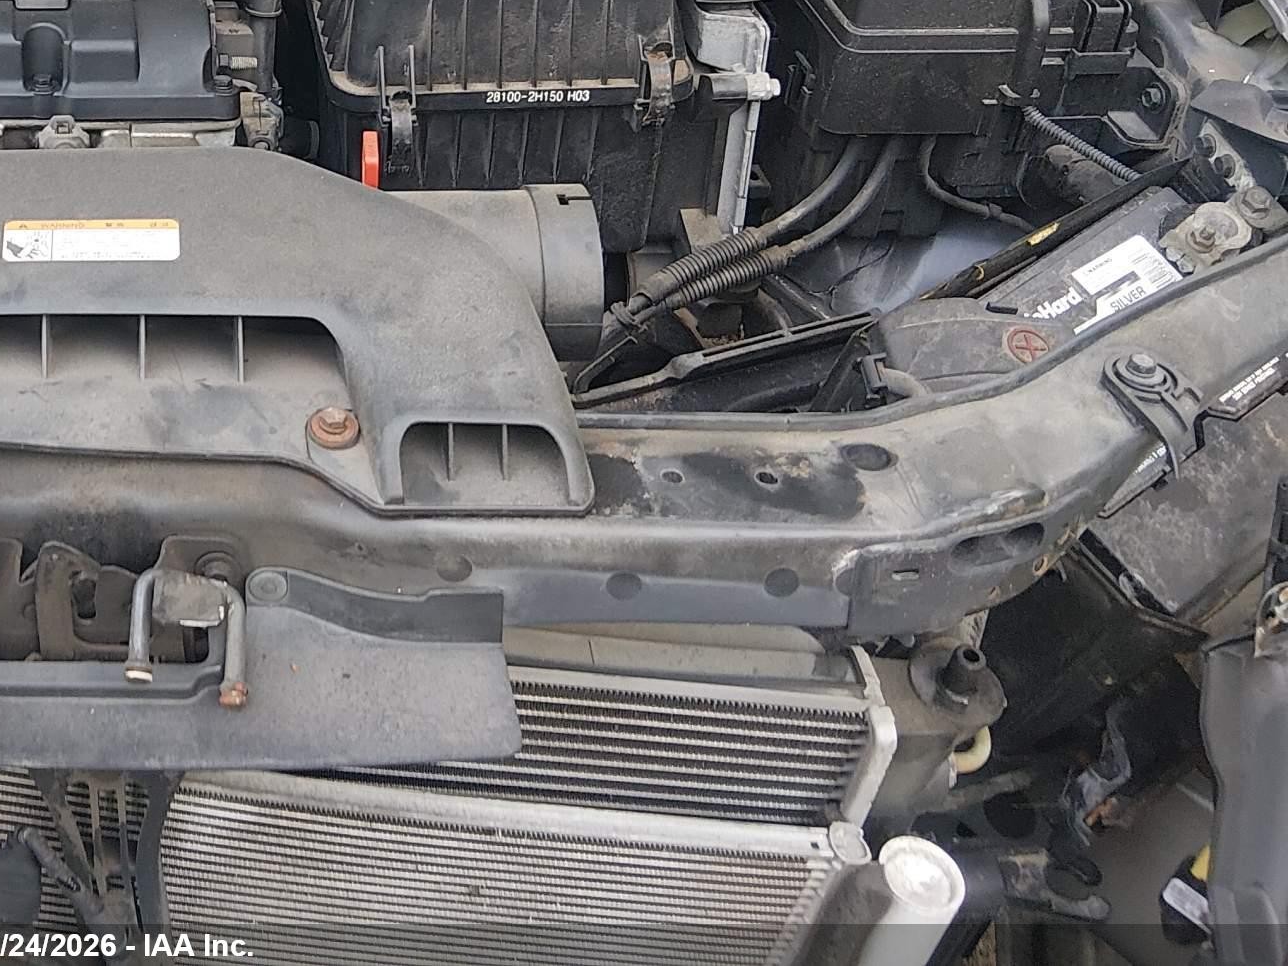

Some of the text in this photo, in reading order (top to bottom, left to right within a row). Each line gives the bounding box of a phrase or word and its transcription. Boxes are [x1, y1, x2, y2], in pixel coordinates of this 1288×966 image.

[486, 89, 590, 103] 28100-2H150 H03
[1110, 285, 1147, 312] SILVER
